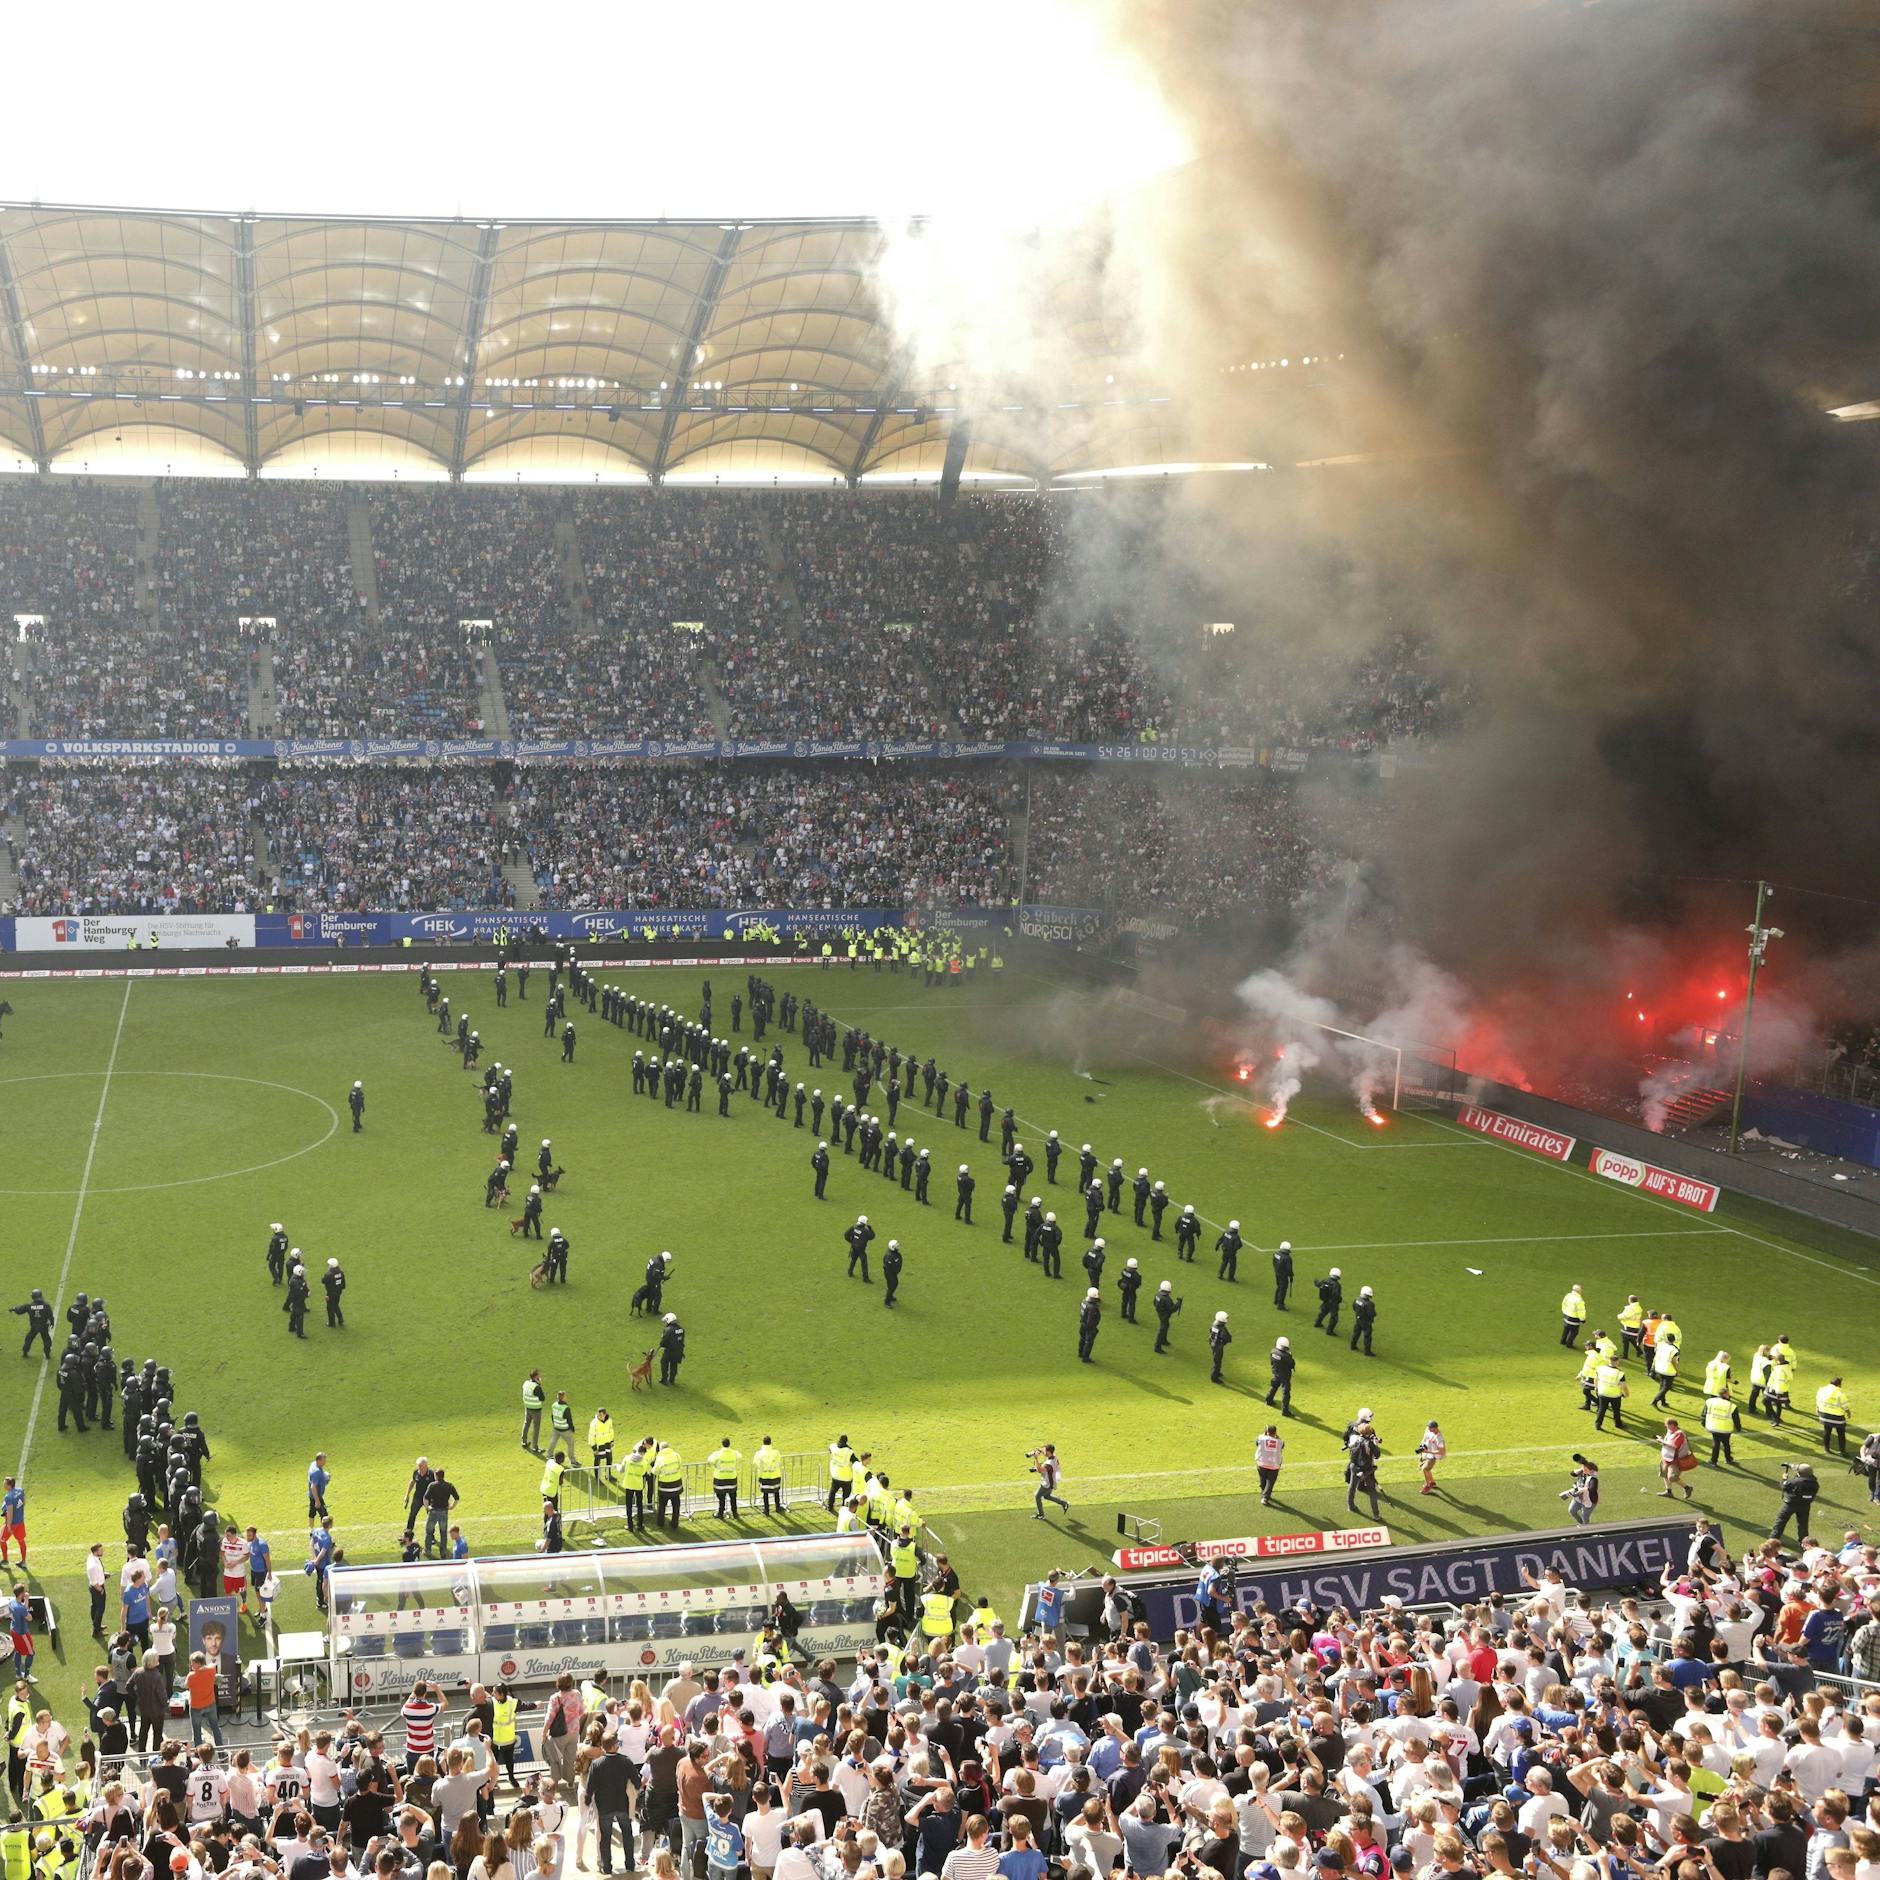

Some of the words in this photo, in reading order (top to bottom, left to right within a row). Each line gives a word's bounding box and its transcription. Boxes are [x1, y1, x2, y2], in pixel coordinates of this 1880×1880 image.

[62, 742, 220, 753] VOLKSPARKSTADION
[1098, 746, 1113, 757] 54
[1142, 747, 1157, 759] 00
[1162, 748, 1177, 759] 20
[320, 913, 339, 922] Der
[634, 914, 707, 923] HANSEATISCHE
[934, 910, 952, 920] Der
[83, 918, 101, 926] Der
[424, 920, 456, 932] HEK
[584, 918, 615, 930] HEK
[83, 925, 138, 936] Hamburger
[84, 934, 106, 945] Weg
[1464, 1107, 1490, 1130] Fly
[1493, 1117, 1564, 1155] Emirates
[1602, 1159, 1639, 1181] popp
[1646, 1172, 1677, 1194] AUF'S
[1677, 1182, 1708, 1205] BROT
[1265, 1536, 1317, 1555] tipico
[1332, 1531, 1382, 1548] tipico
[1172, 1587, 1265, 1630] DR
[1280, 1571, 1373, 1613] HSV
[1387, 1558, 1500, 1609] SAGT
[1515, 1537, 1674, 1588] DANKE!
[201, 1781, 213, 1801] 8
[277, 1780, 300, 1802] 40
